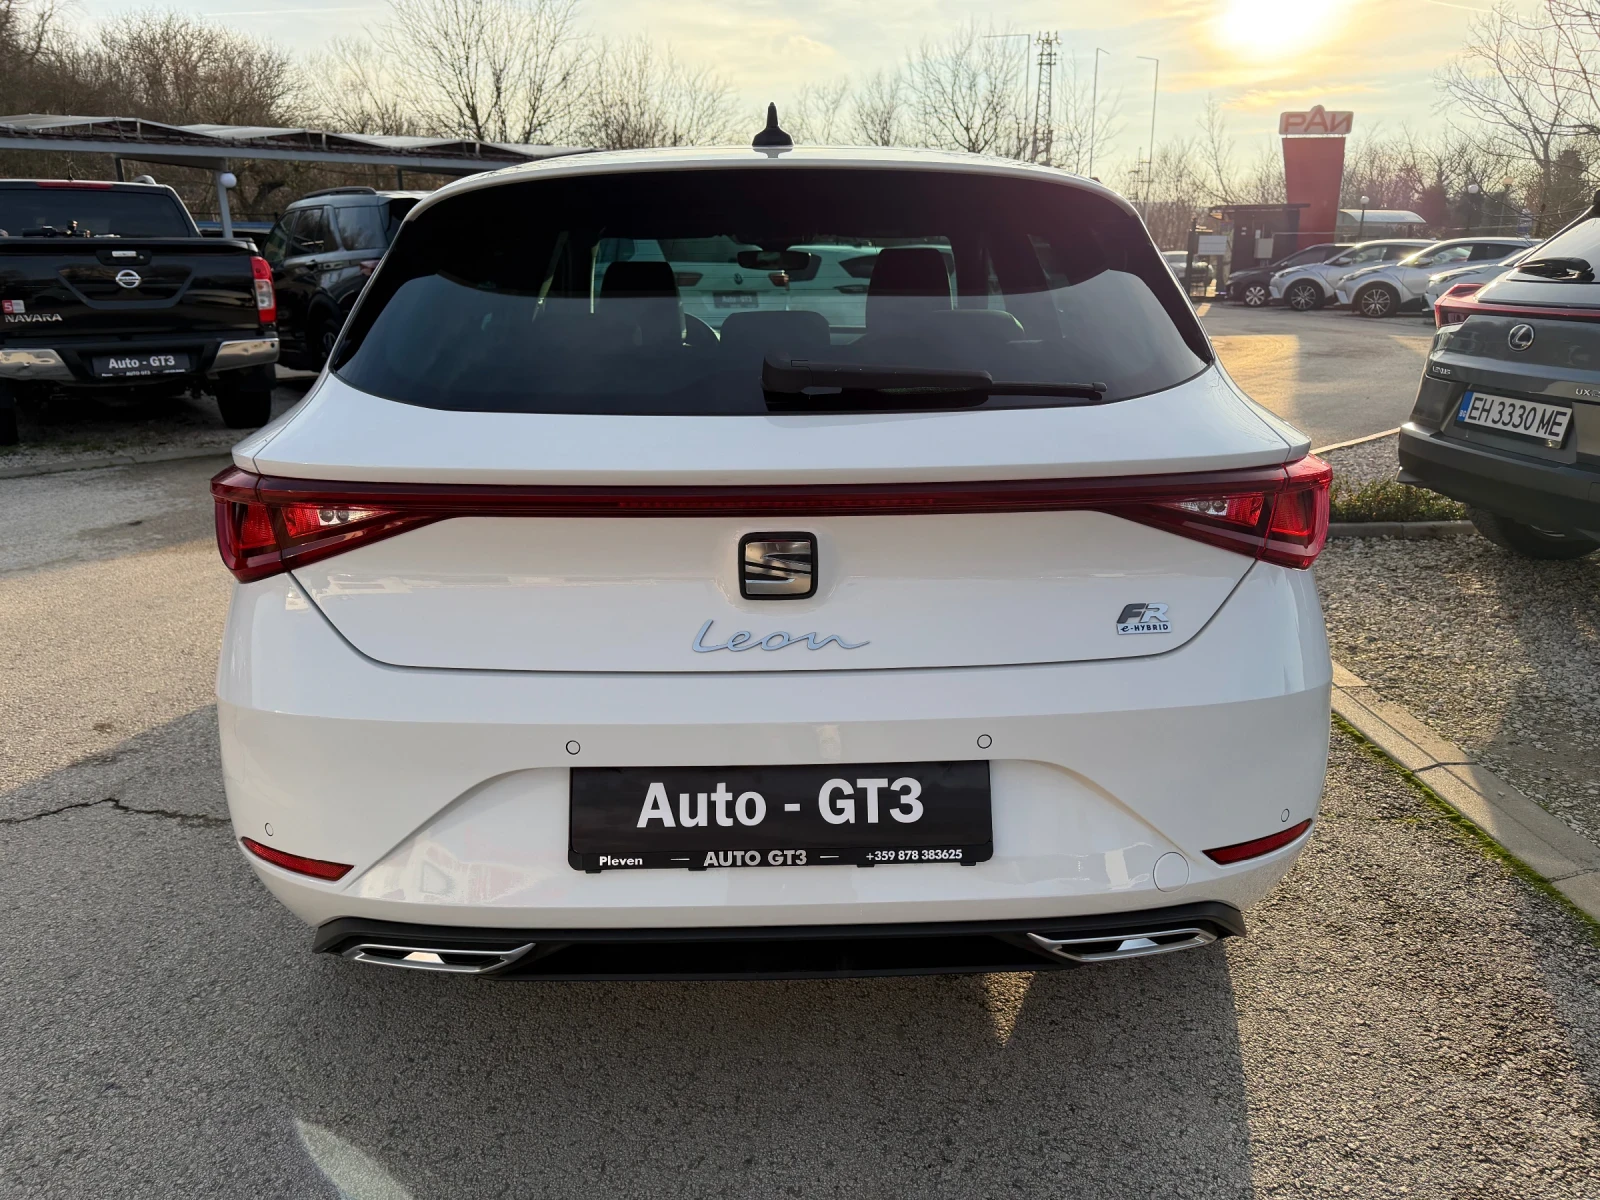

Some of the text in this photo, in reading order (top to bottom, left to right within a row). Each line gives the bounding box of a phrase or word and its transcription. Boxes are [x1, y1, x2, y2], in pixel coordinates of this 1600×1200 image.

[4, 313, 63, 323] NAVARA
[108, 358, 140, 369] Auto
[149, 355, 176, 367] GT3
[1575, 388, 1591, 396] UX
[1468, 397, 1567, 437] EH 3330 ME
[1116, 603, 1169, 623] FR
[1120, 624, 1168, 632] e-HYBRID
[692, 618, 870, 653] Leon
[636, 782, 767, 829] Auto
[818, 776, 925, 825] GT3
[599, 855, 643, 866] Pleven
[703, 849, 808, 867] AUTO GT3
[865, 848, 963, 861] +359 878 383625
